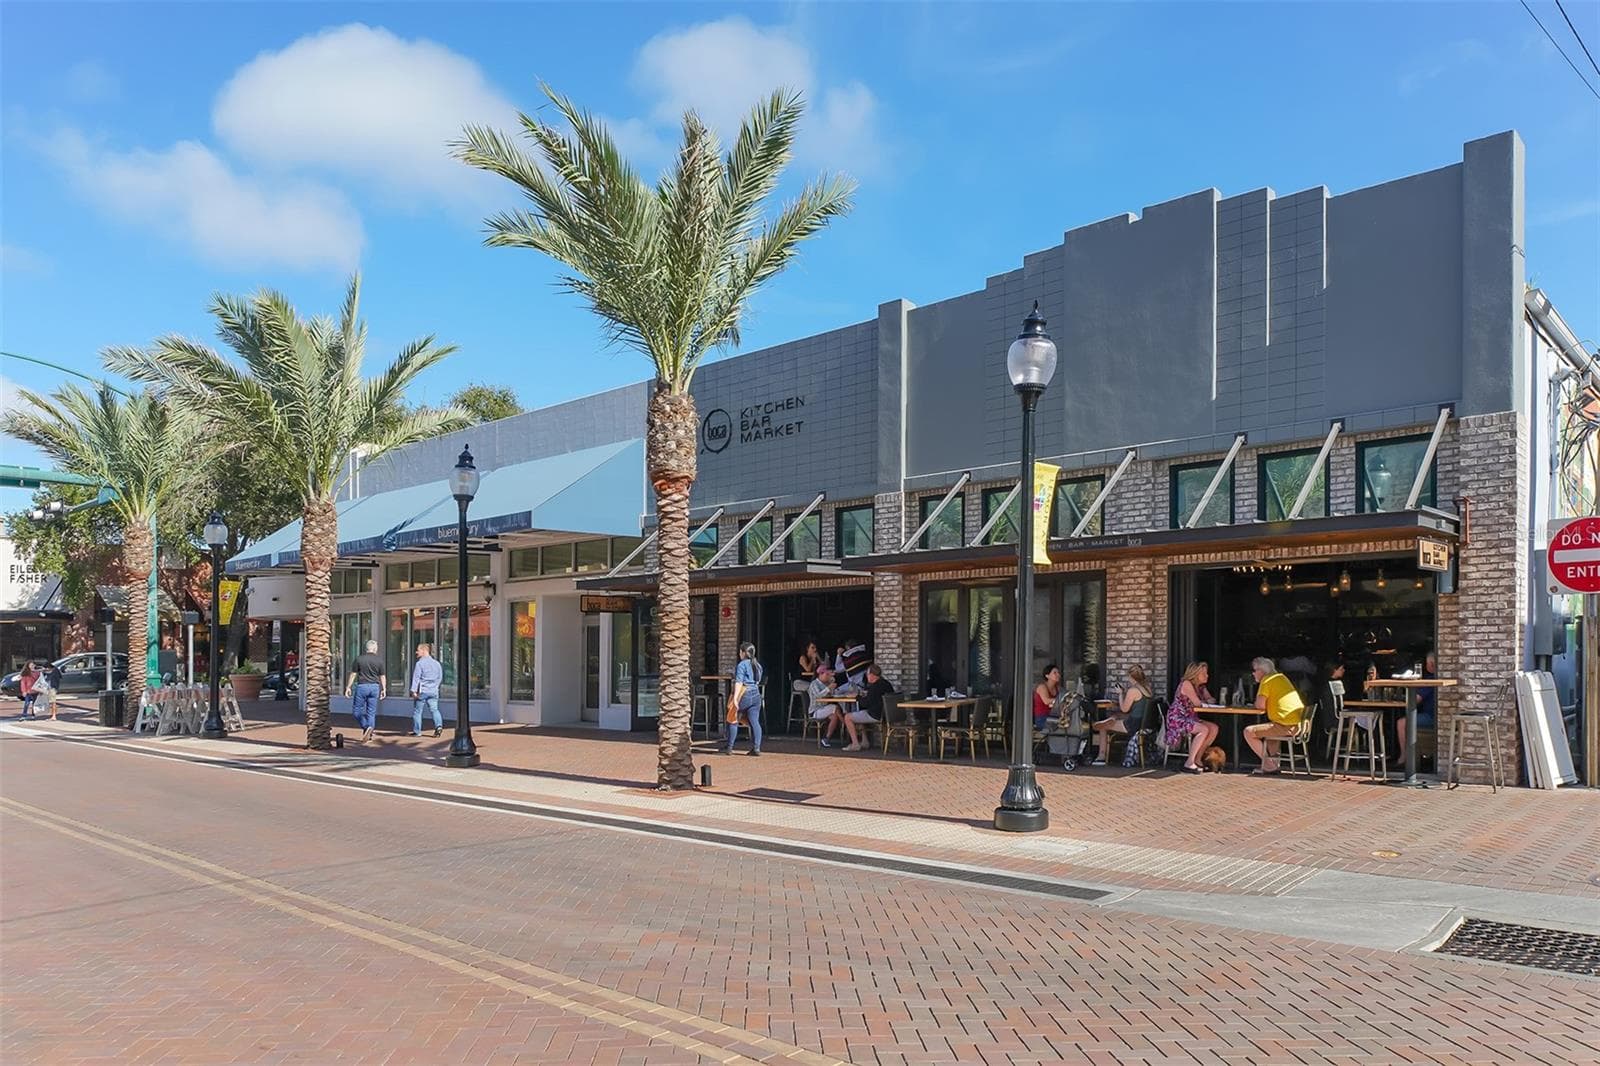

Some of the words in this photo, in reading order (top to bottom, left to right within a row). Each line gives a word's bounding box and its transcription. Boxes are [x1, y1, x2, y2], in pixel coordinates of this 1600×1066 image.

[741, 397, 805, 419] KITCHEN
[707, 419, 727, 440] boca
[741, 416, 771, 431] BAR
[741, 421, 804, 444] MARKET
[1561, 534, 1582, 546] DO
[10, 564, 36, 574] EILE
[1567, 566, 1600, 578] ENT
[10, 574, 47, 584] FISHER
